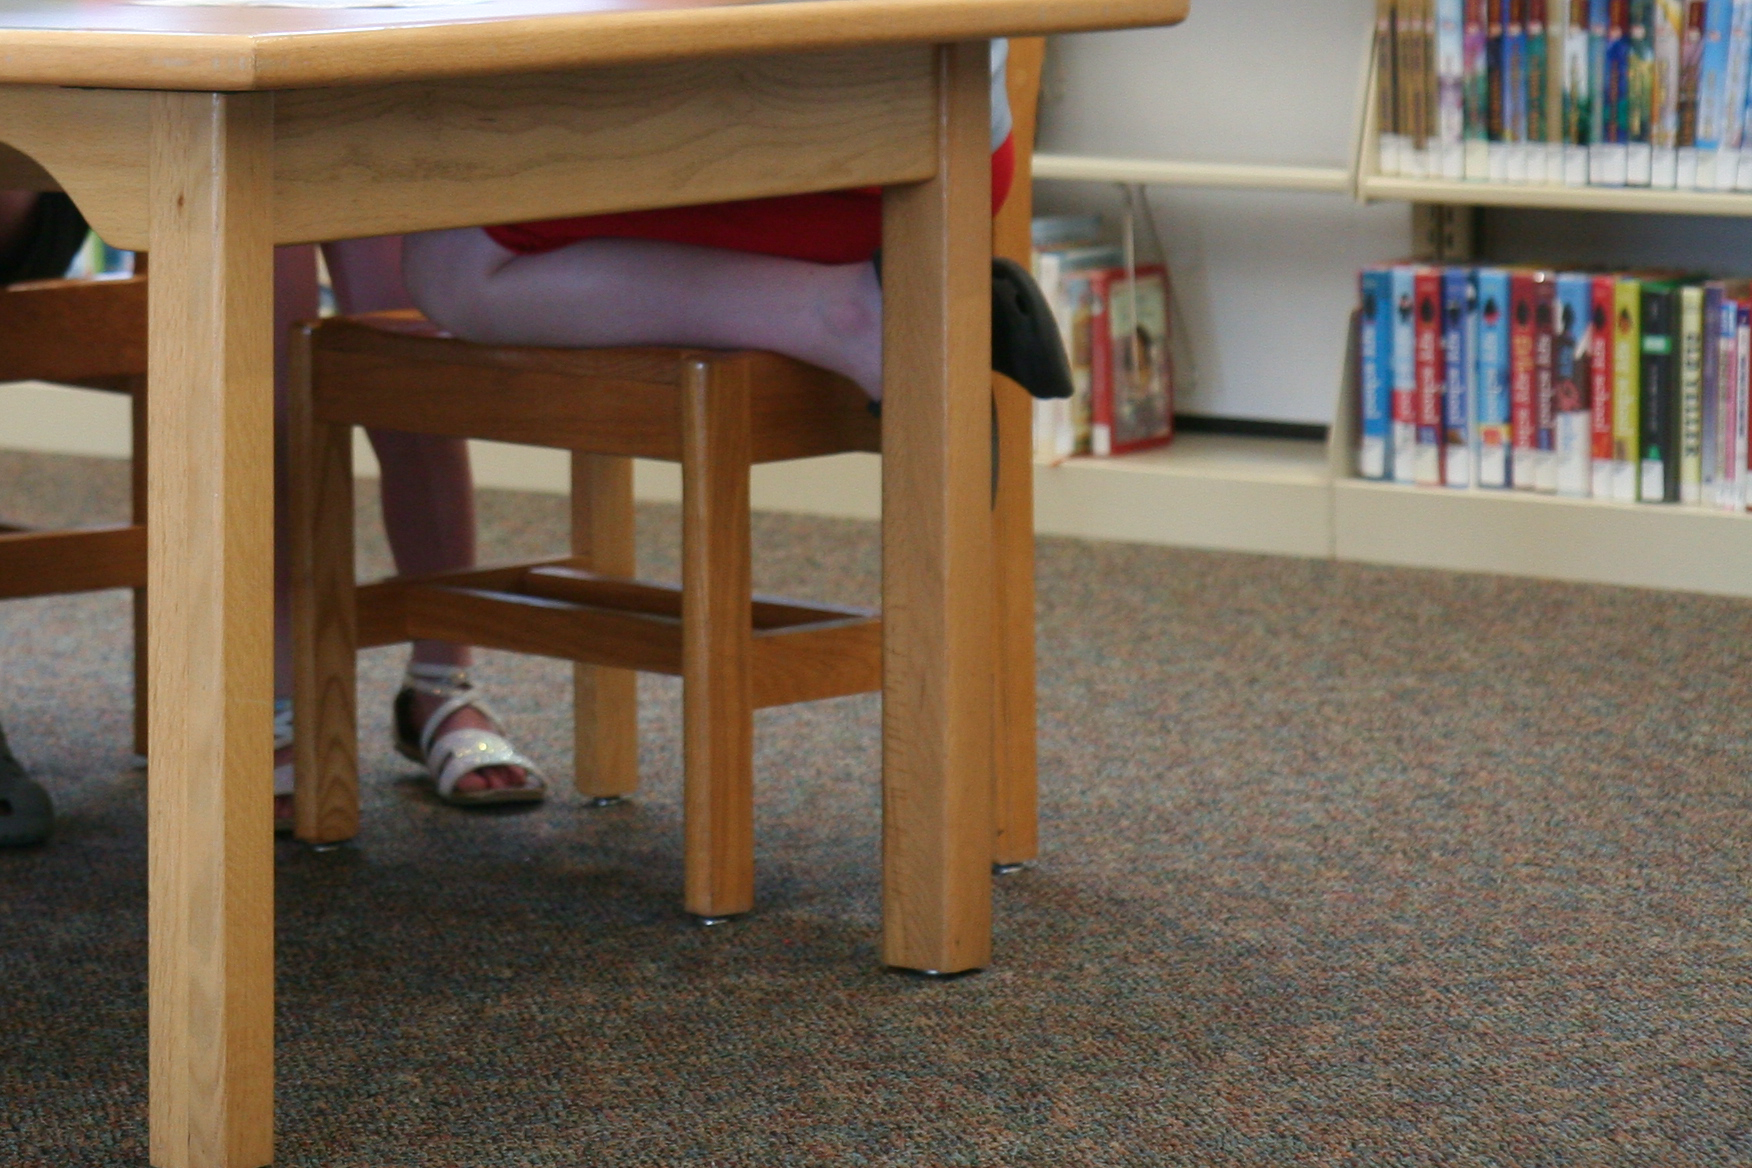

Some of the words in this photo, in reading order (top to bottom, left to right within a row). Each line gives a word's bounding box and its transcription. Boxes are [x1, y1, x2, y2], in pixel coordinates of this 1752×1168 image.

[1365, 361, 1381, 419] school
[1422, 365, 1439, 423] school
[1450, 367, 1466, 424] school
[1539, 370, 1554, 429] school
[1595, 374, 1609, 433] school
[1617, 377, 1634, 437] school
